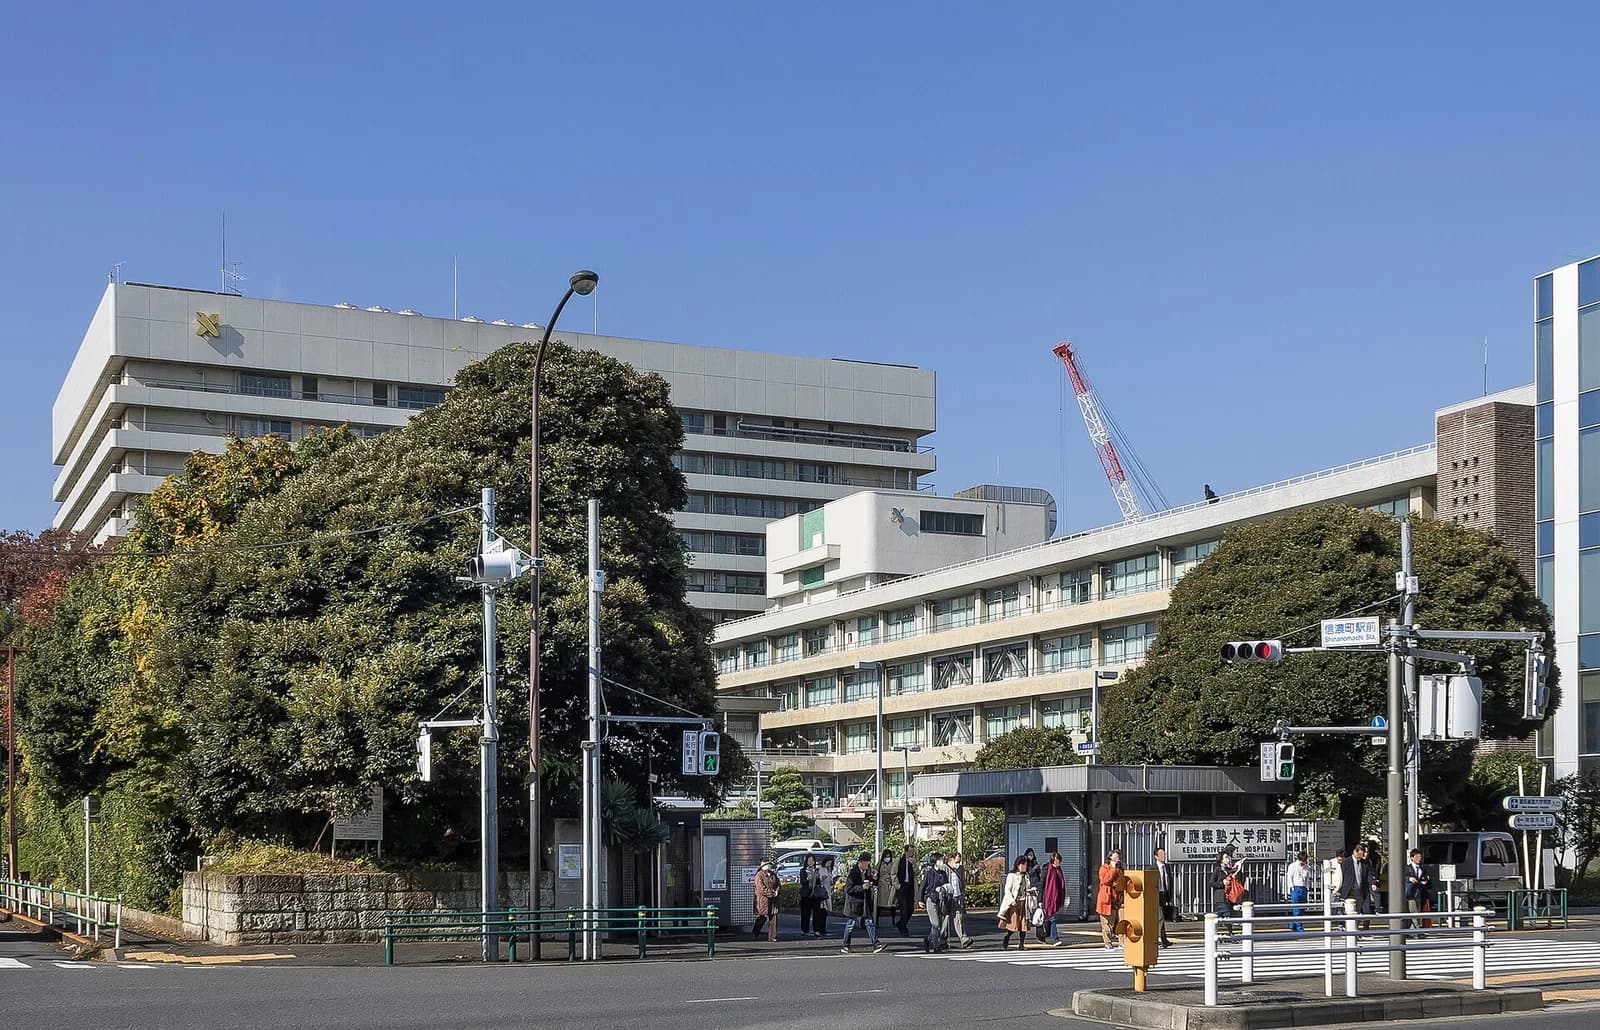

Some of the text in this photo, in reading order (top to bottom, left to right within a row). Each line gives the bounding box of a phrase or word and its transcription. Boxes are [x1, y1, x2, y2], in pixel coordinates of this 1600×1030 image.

[1324, 621, 1376, 635] 信濃町駅前
[1324, 634, 1364, 643] Shinanomachi
[1174, 828, 1282, 844] 慶應義塾大学病院
[1182, 846, 1197, 854] KEIO
[1244, 845, 1276, 853] HOSPITAL
